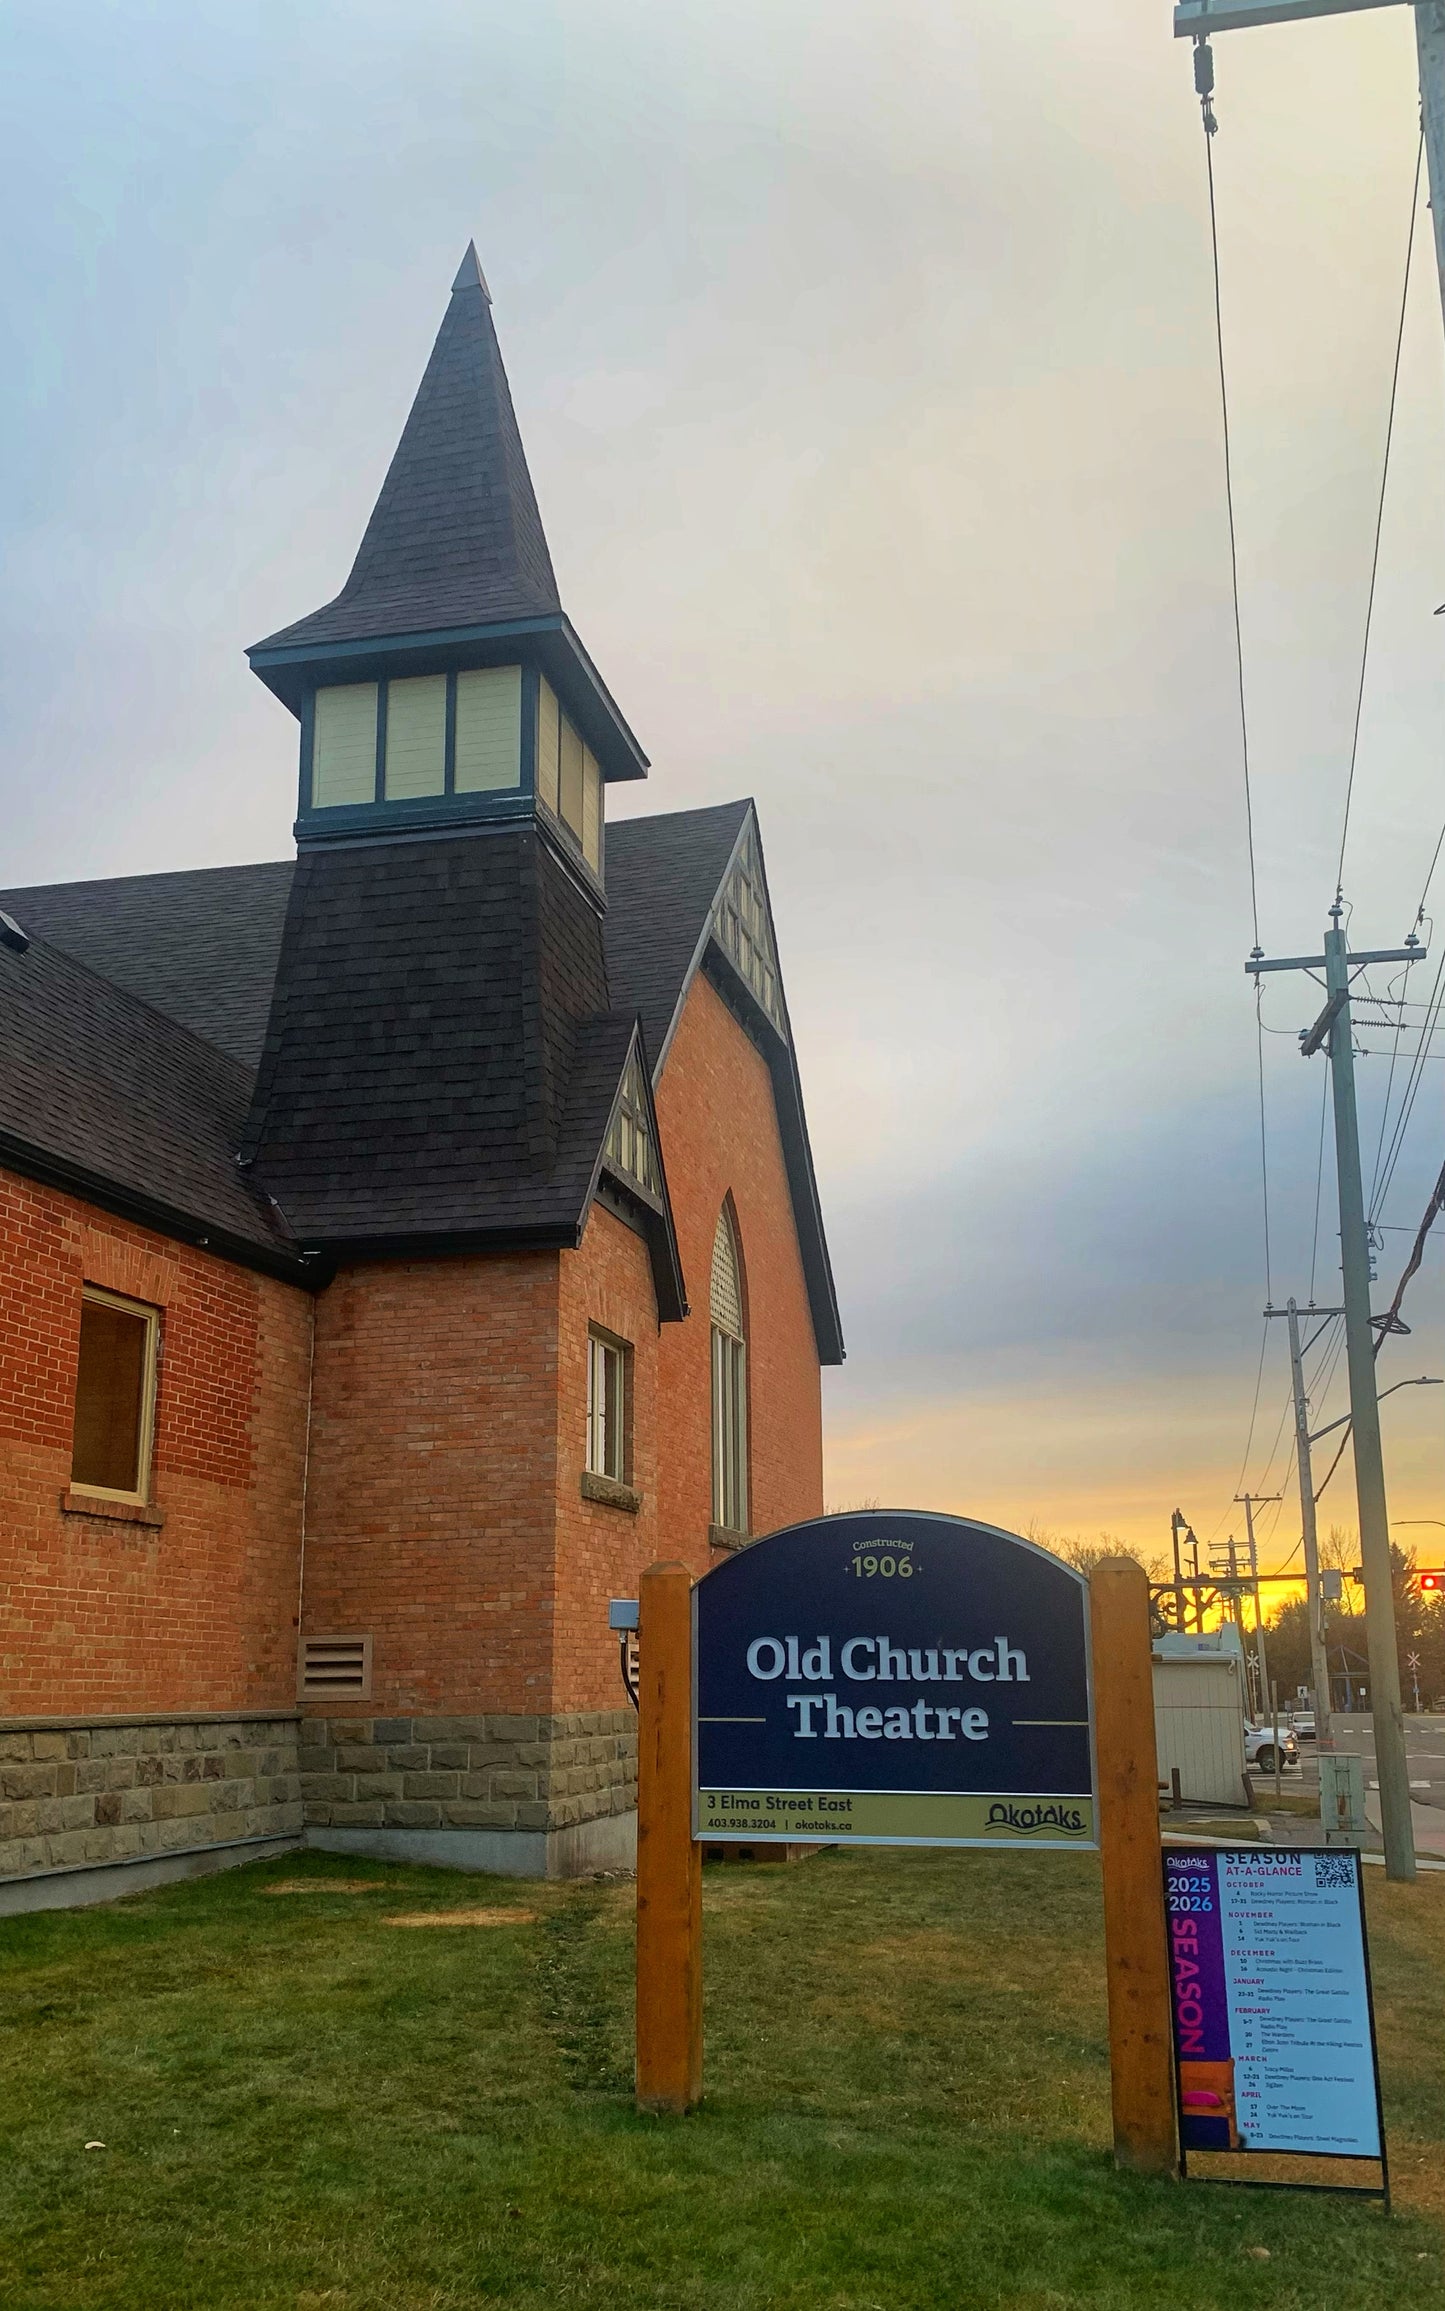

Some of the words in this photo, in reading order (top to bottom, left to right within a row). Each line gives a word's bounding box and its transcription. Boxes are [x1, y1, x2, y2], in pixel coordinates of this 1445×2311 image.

[853, 1539, 914, 1551] Constructed
[852, 1556, 913, 1577] 1906
[746, 1635, 834, 1681] Old
[840, 1635, 1031, 1682] Church
[786, 1693, 989, 1741] Theatre
[707, 1795, 716, 1809] 3
[721, 1795, 760, 1810] Elma
[766, 1796, 813, 1810] Street
[818, 1797, 853, 1811] East
[989, 1803, 1080, 1829] Okotoks
[708, 1818, 776, 1829] 403.938.3204
[795, 1820, 852, 1831] okotoks.ca
[1167, 1857, 1207, 1868] Okotoks
[1225, 1853, 1302, 1864] SEASON
[1226, 1867, 1302, 1876] AT-A-GLANCE
[1168, 1877, 1211, 1892] 2025
[1169, 1896, 1213, 1911] 2026
[1172, 1918, 1205, 2053] SEASON
